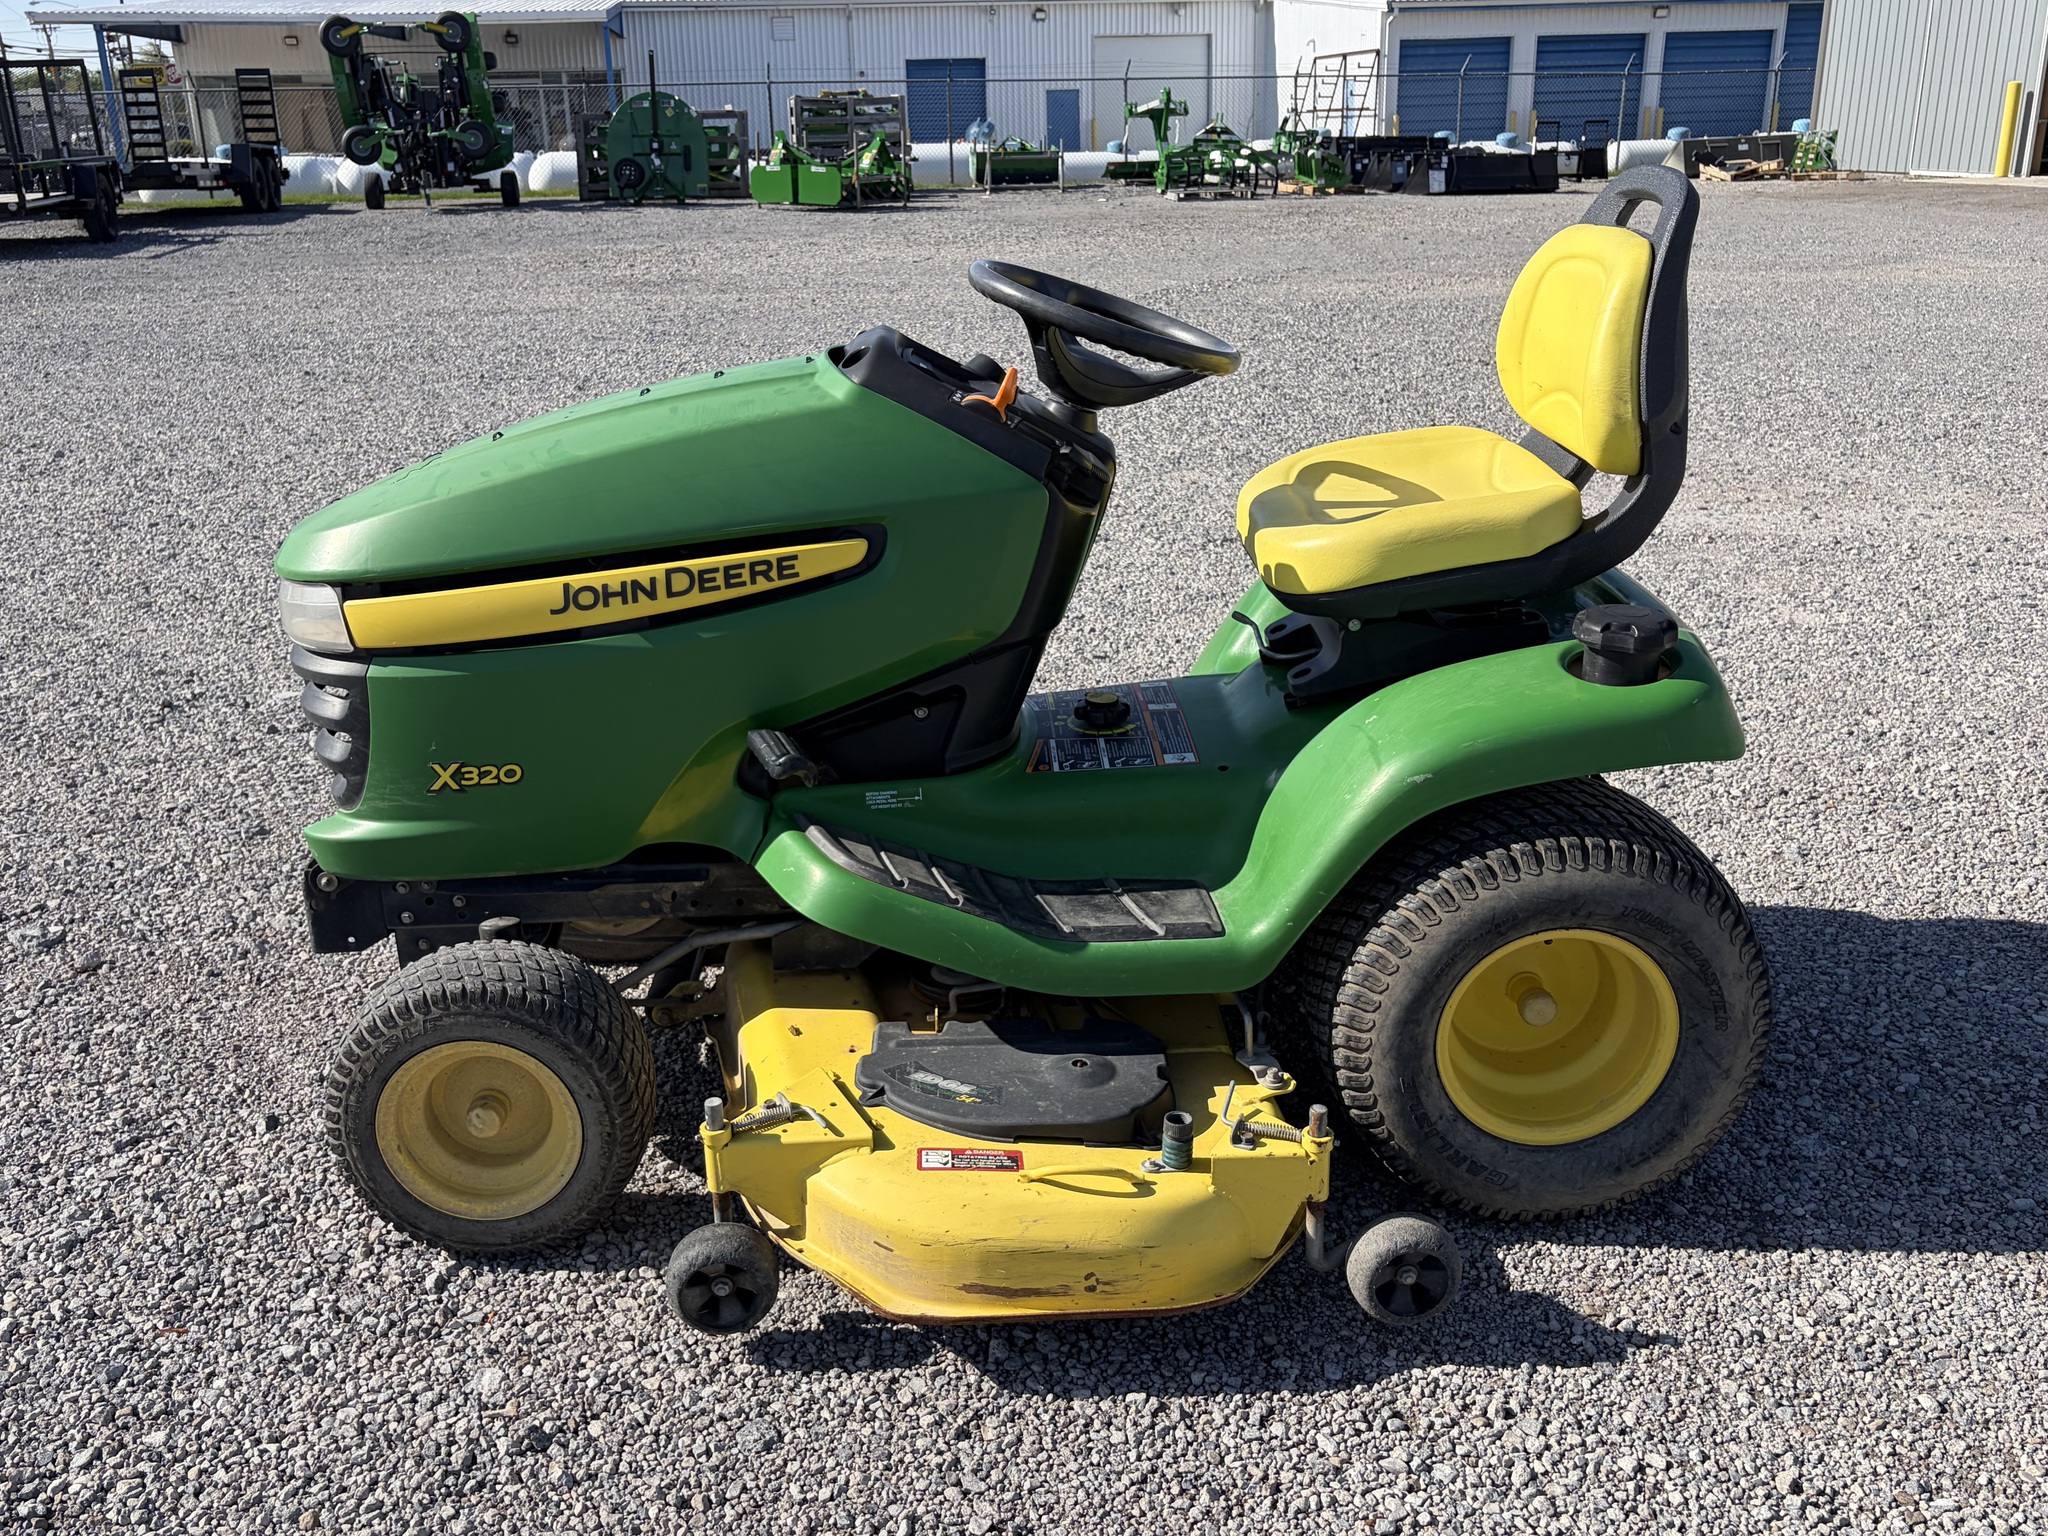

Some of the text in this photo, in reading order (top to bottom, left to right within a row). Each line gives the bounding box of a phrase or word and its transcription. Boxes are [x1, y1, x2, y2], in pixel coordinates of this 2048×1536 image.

[550, 555, 800, 616] JOHN DEERE
[428, 762, 523, 793] X320
[1620, 904, 1729, 1032] TURF MASTER
[1399, 1076, 1508, 1187] CARLISLE
